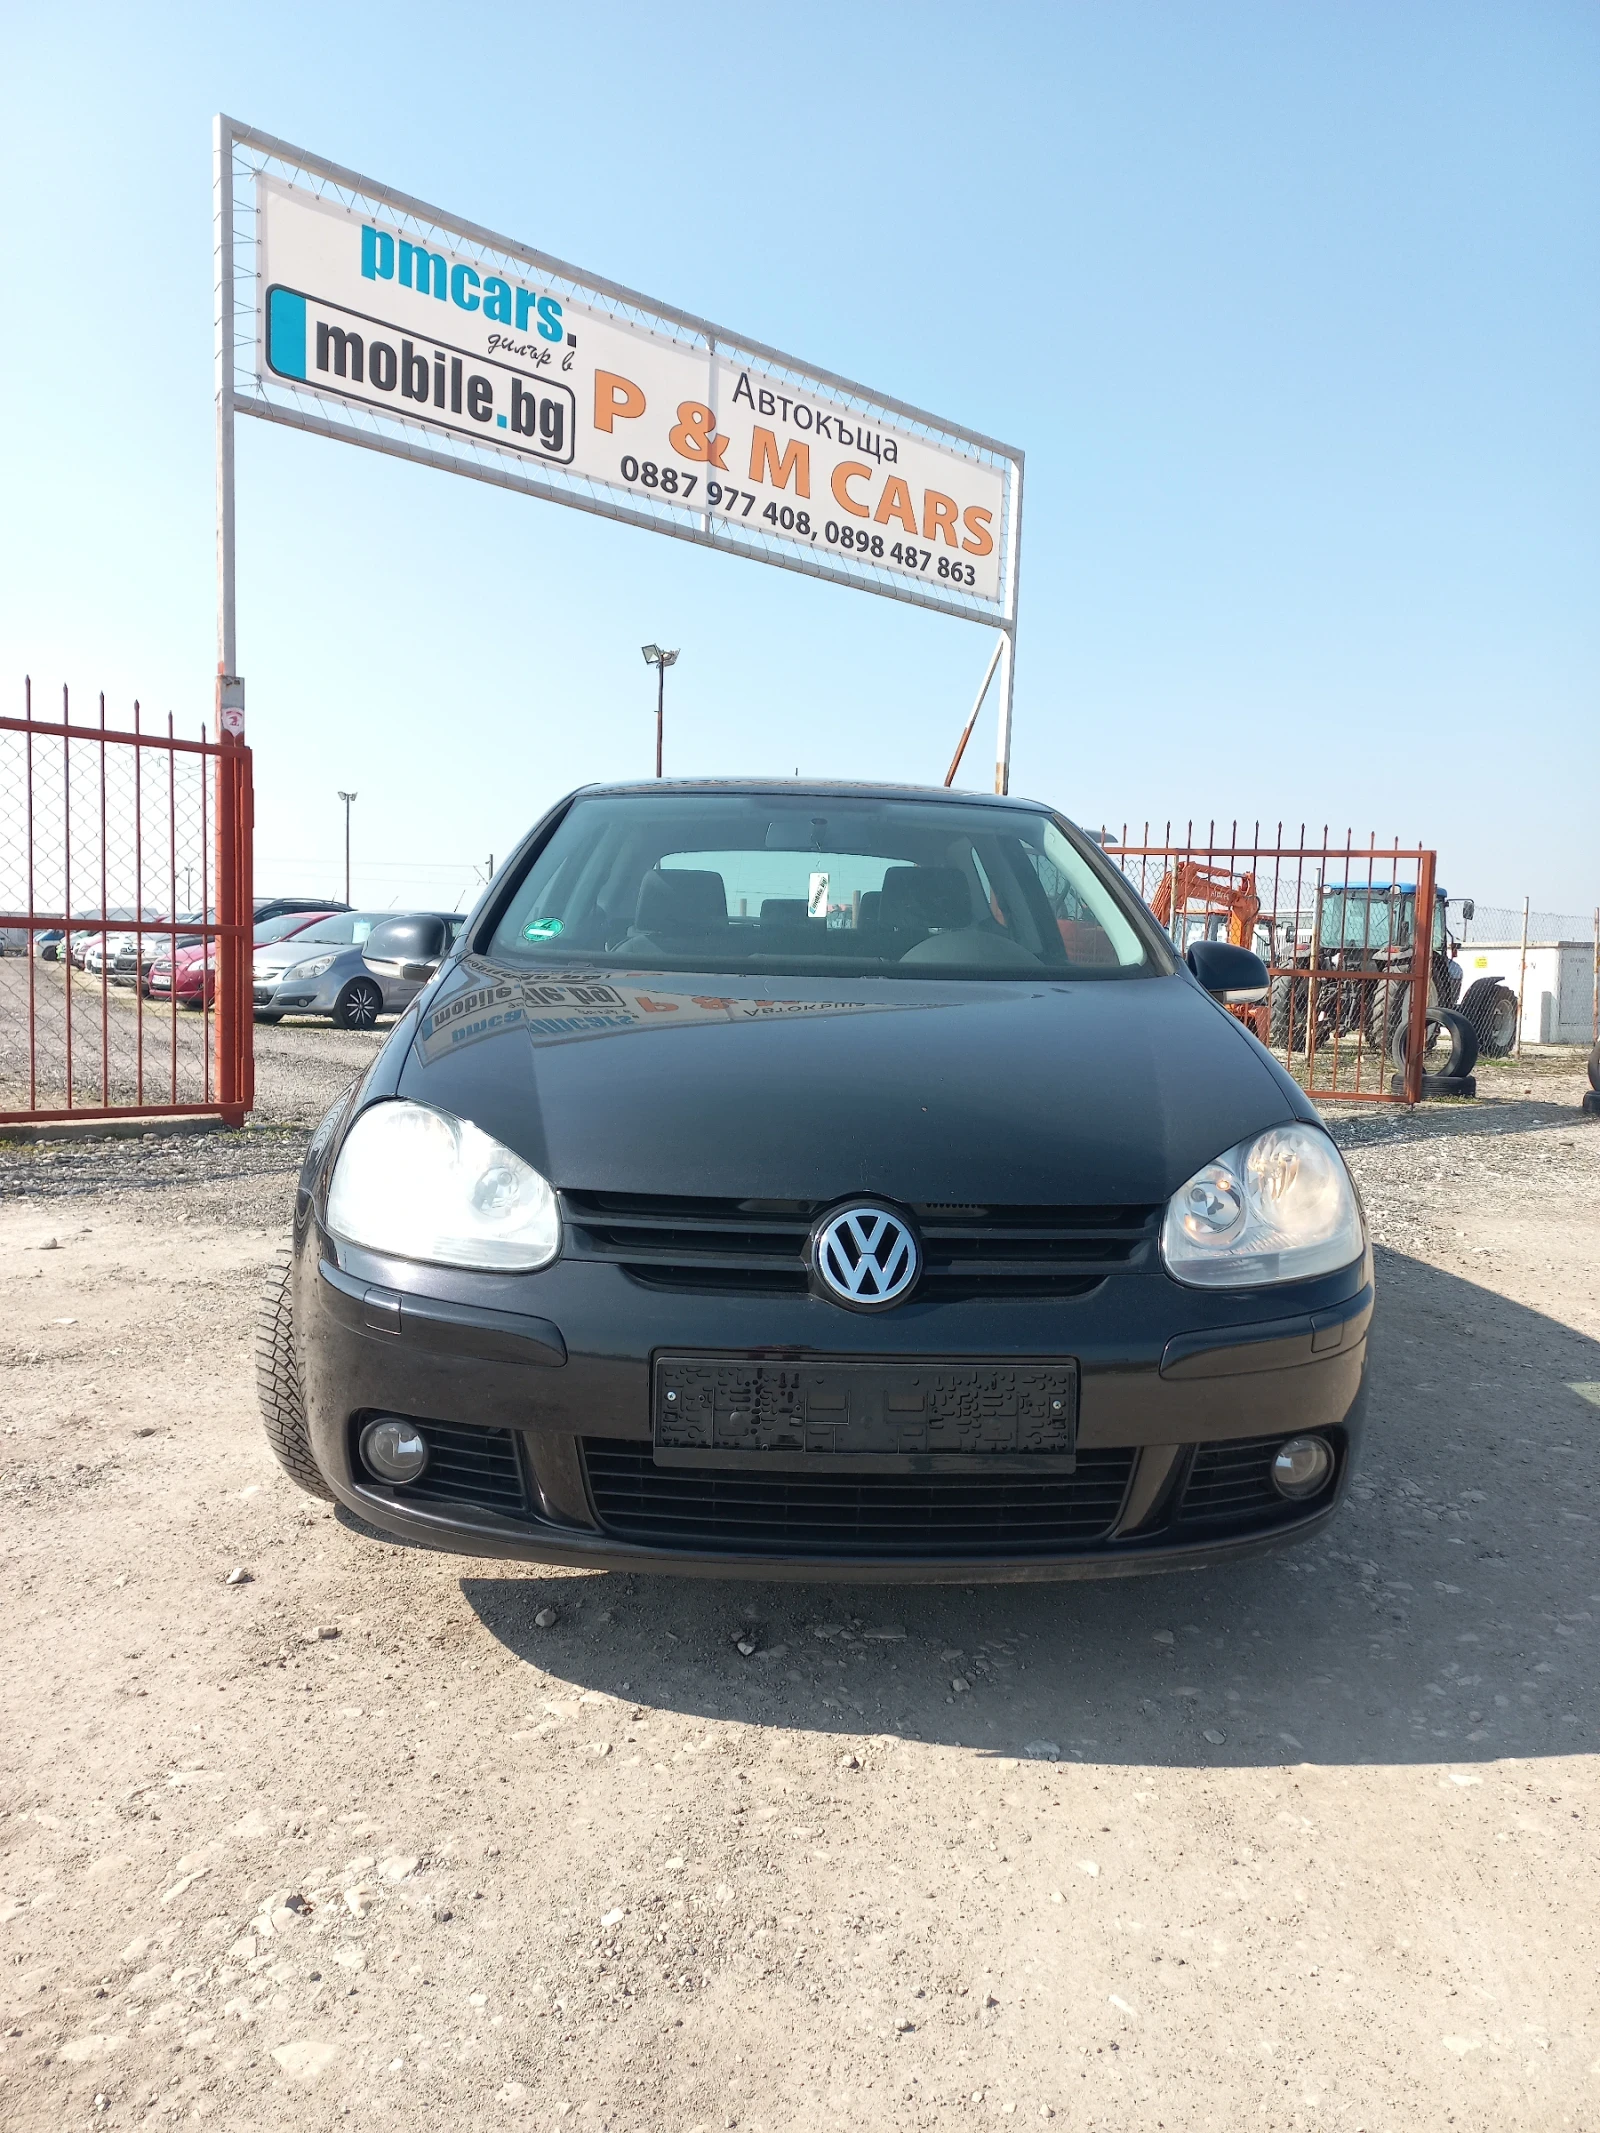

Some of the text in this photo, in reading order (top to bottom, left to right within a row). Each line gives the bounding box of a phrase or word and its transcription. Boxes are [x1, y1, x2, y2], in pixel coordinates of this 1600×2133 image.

[361, 224, 577, 348] pmcars.
[316, 320, 564, 452] mobile.bg
[731, 372, 898, 465] Автокъща
[593, 368, 995, 557] P & M CARS
[620, 455, 977, 587] 0887 977 408, 0898 487 863
